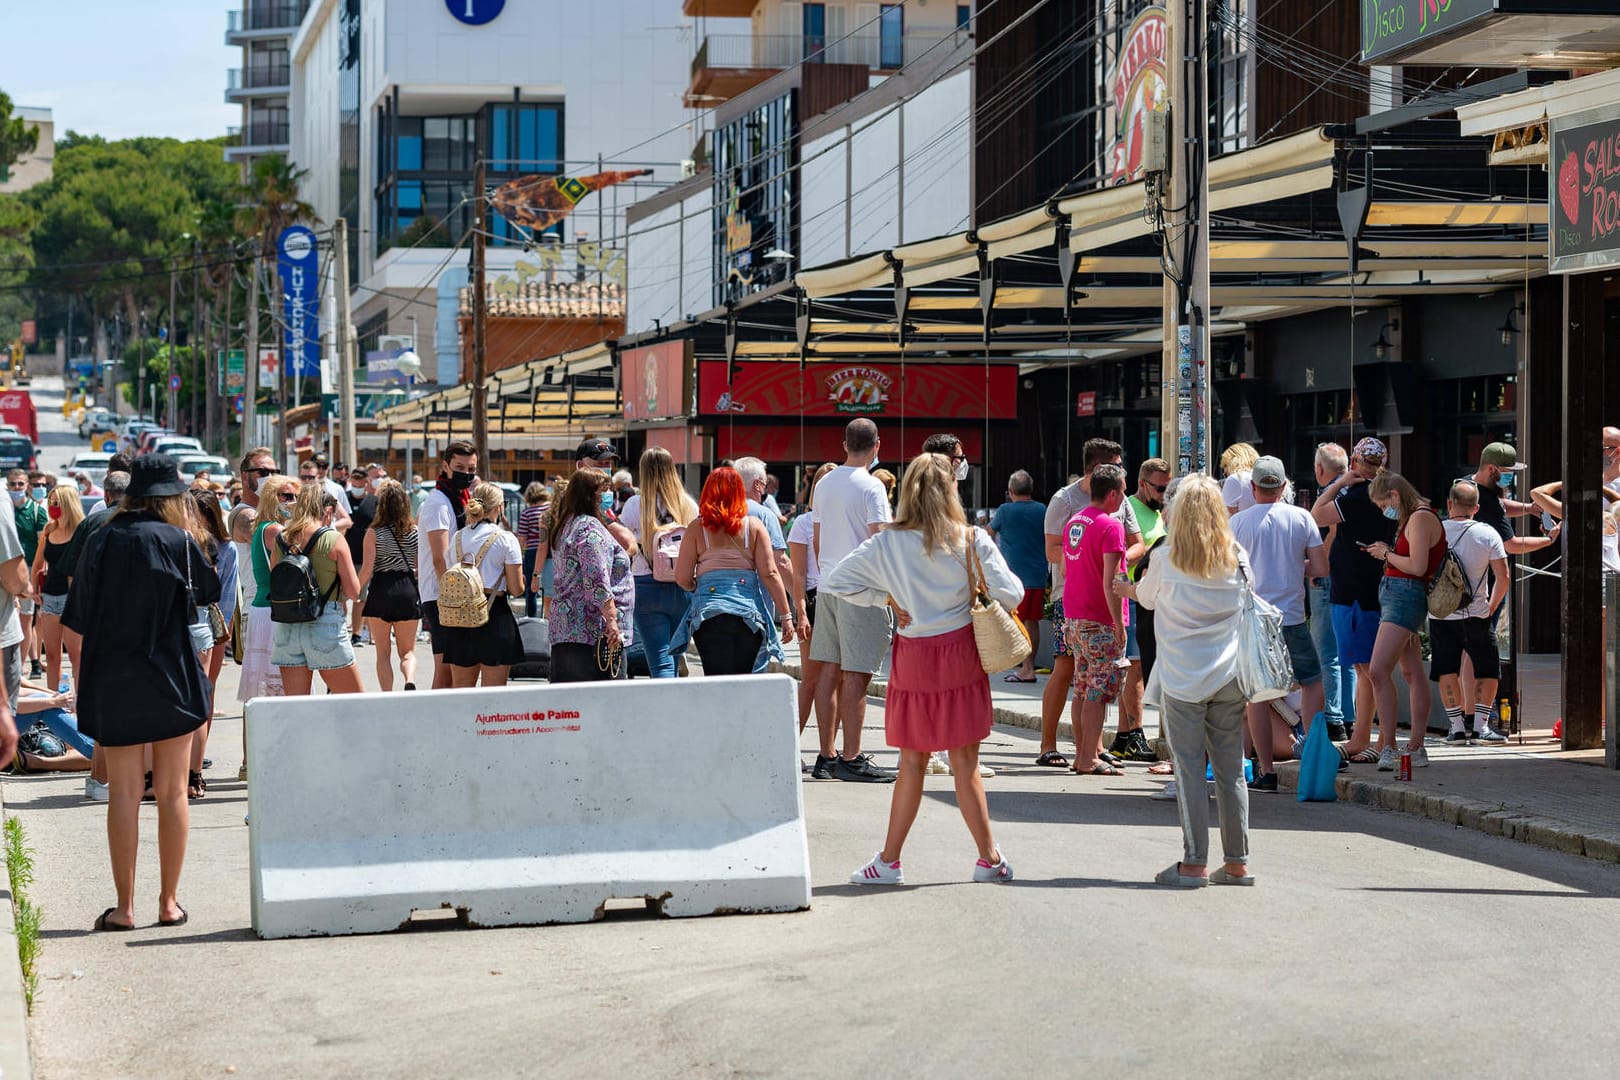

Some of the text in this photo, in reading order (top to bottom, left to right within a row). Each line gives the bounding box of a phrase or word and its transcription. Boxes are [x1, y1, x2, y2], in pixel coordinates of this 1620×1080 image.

[1591, 185, 1620, 238] RO
[827, 368, 891, 388] BIERKÖNIG
[475, 709, 580, 725] Ajuntament de Palma
